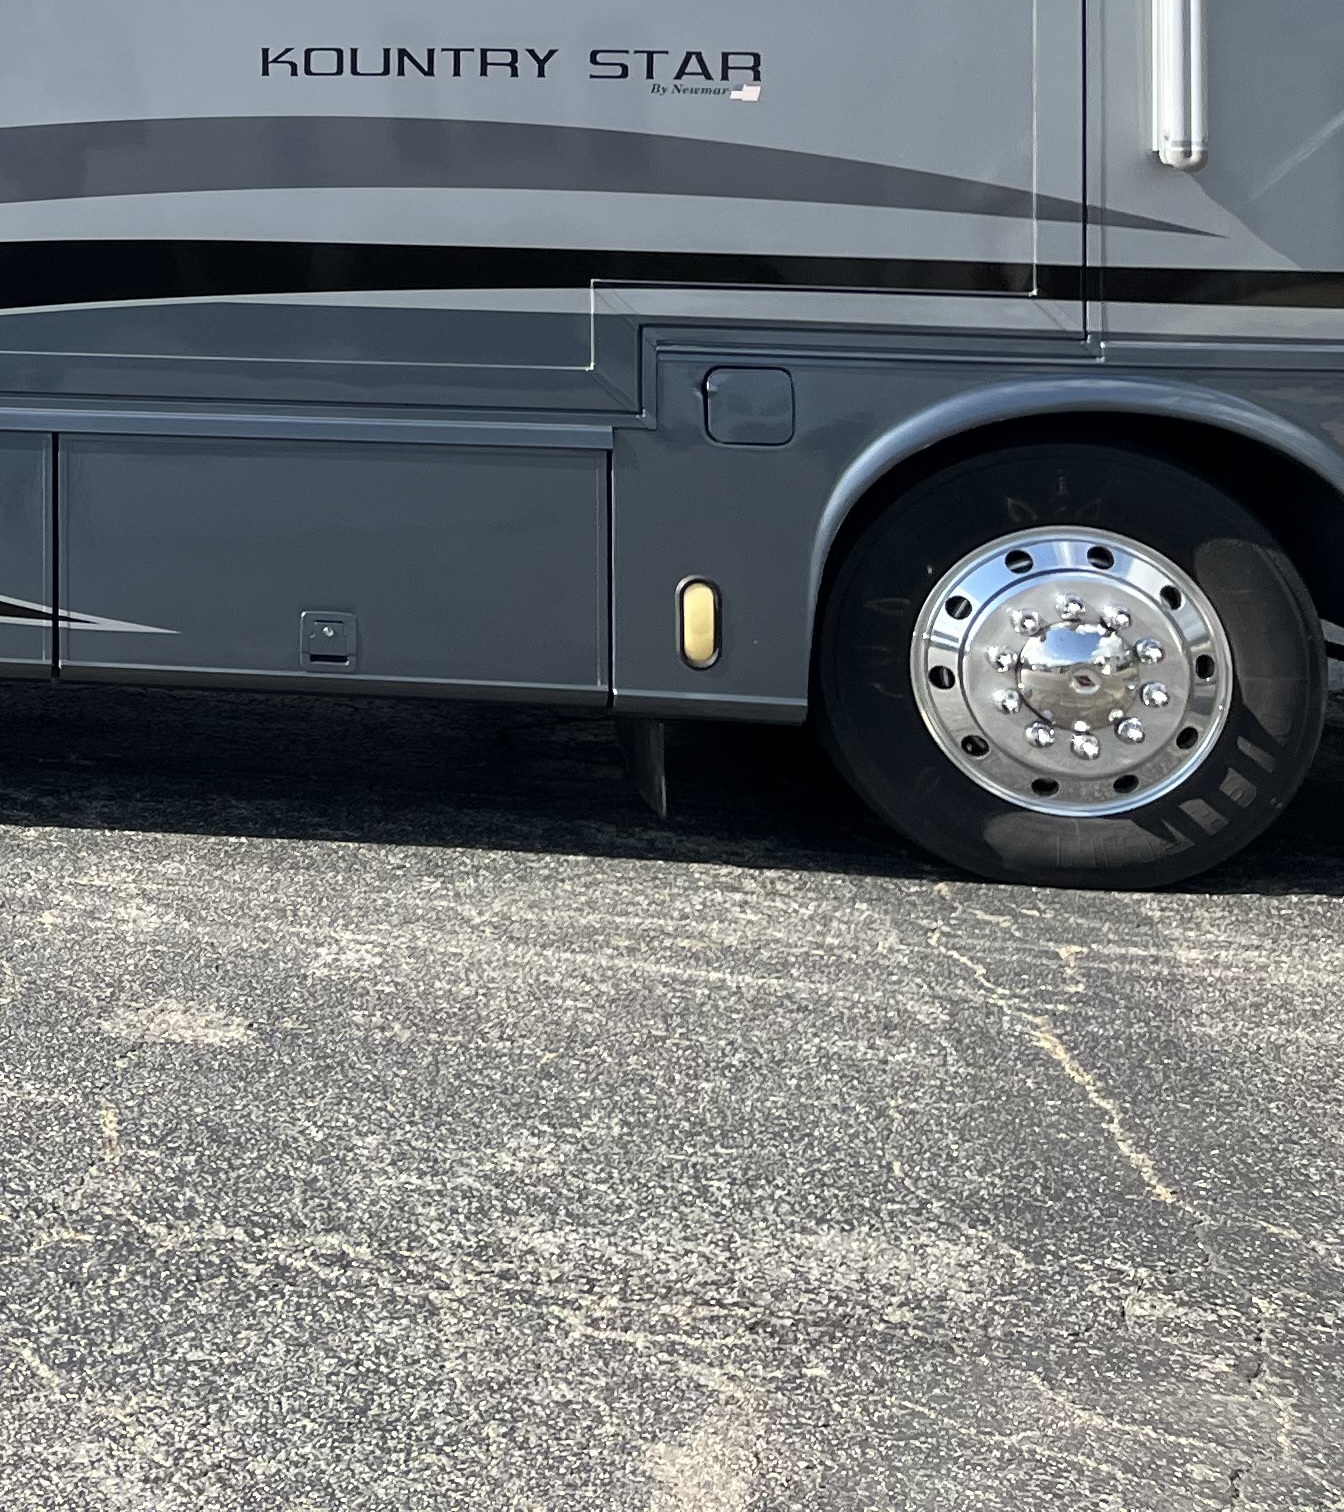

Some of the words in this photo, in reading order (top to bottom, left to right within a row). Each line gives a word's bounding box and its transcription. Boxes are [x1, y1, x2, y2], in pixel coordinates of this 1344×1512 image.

[261, 47, 558, 78] KOUNTRY
[589, 49, 762, 82] STAR
[651, 83, 668, 96] By
[672, 83, 729, 95] Newmar
